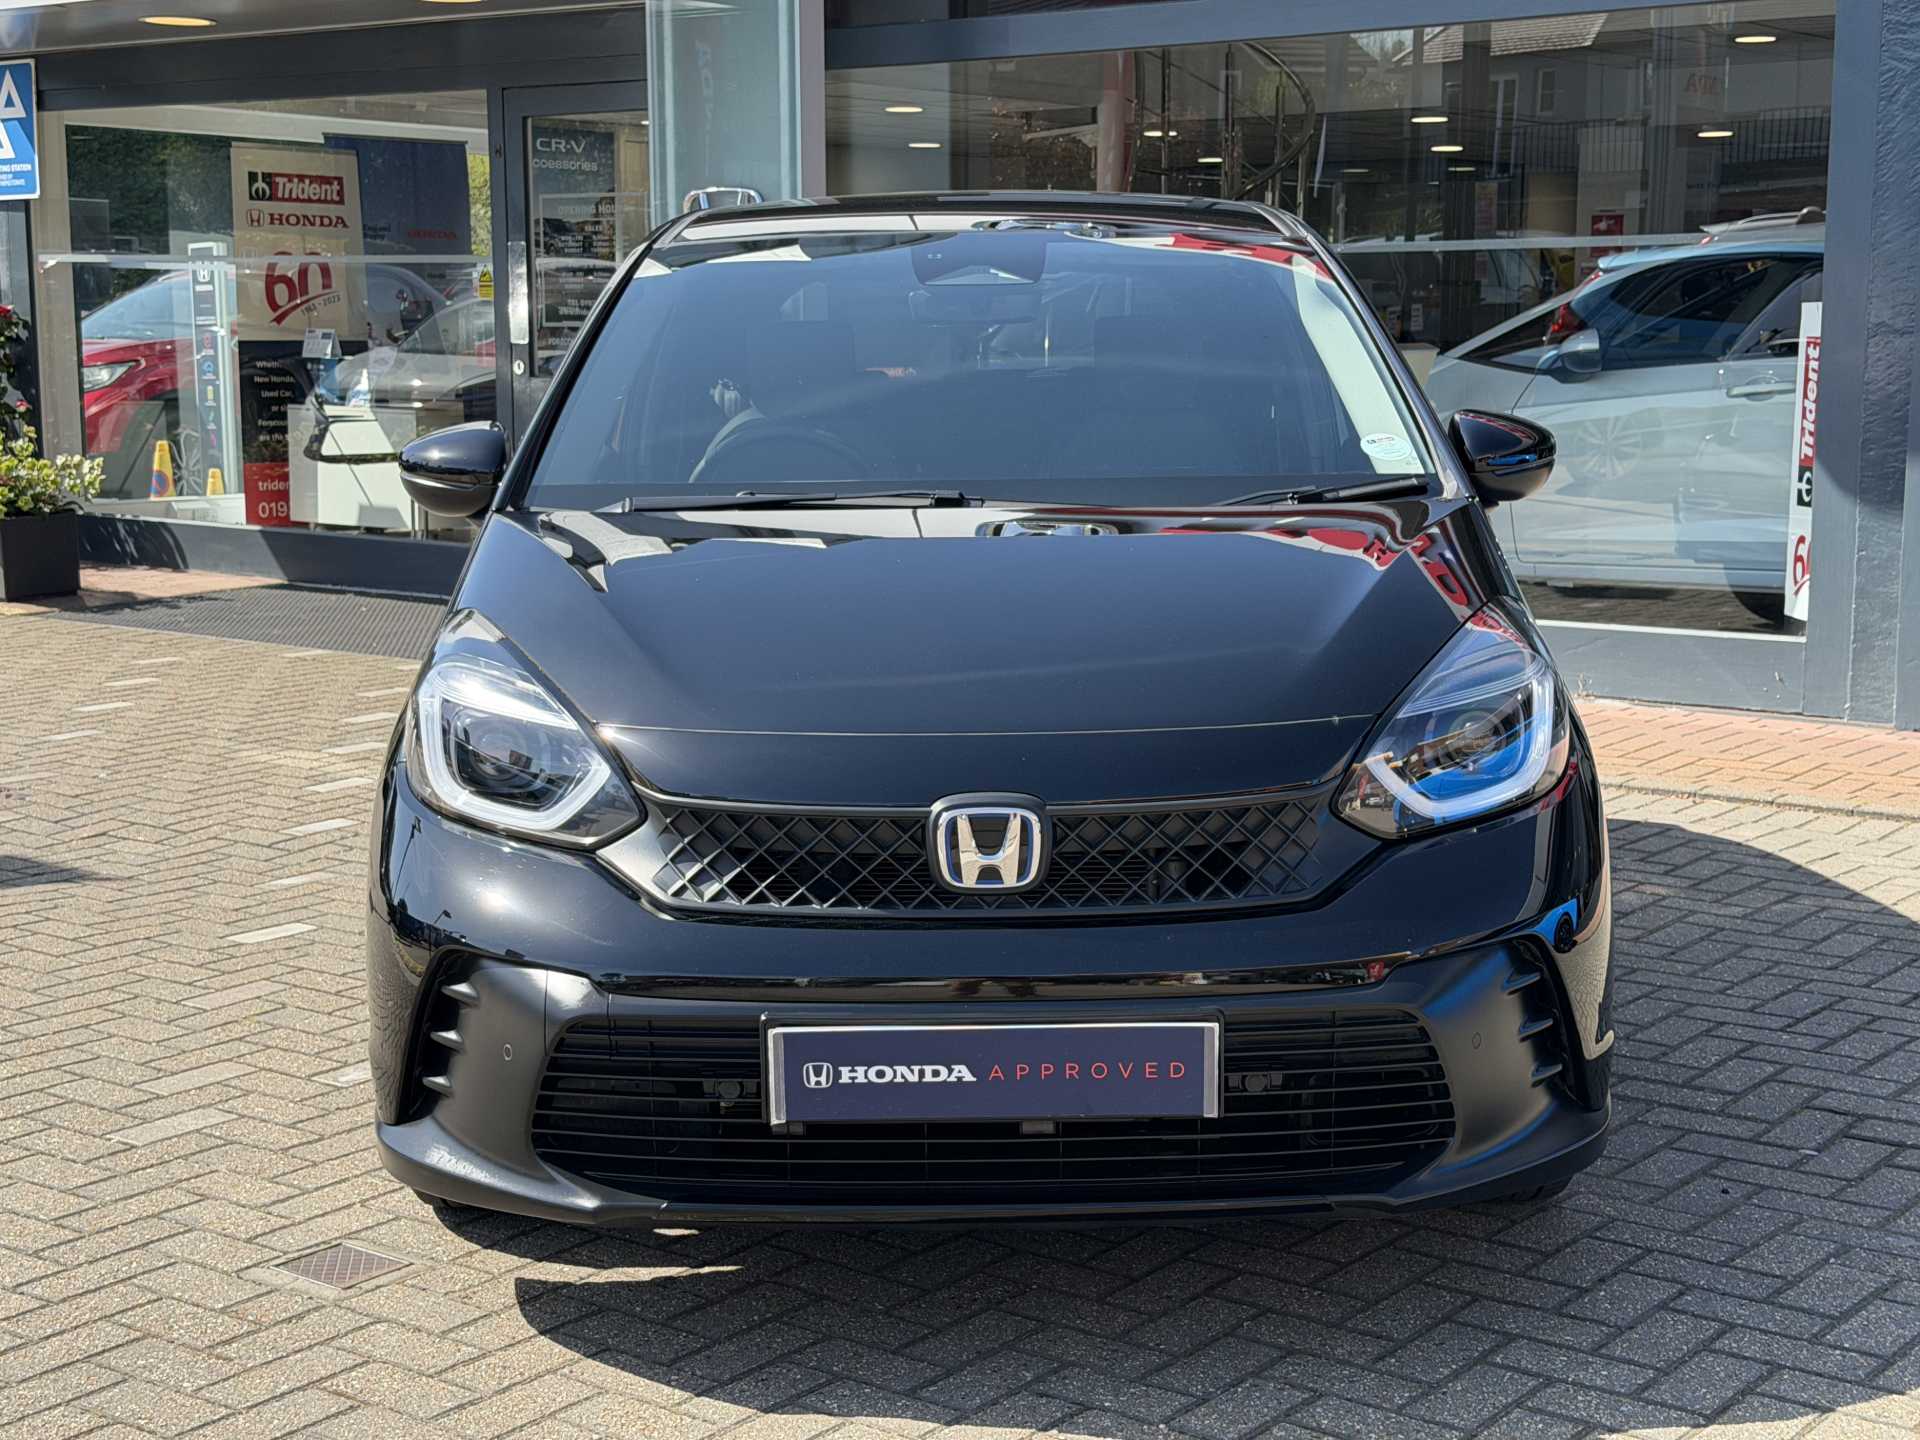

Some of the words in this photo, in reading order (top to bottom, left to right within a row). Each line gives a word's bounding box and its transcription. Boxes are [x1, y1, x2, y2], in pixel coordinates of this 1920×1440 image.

[275, 176, 341, 201] Trident
[268, 212, 350, 229] HONDA
[1801, 342, 1822, 459] Trident
[1793, 535, 1810, 592] 6
[838, 1064, 976, 1083] HONDA
[988, 1061, 1186, 1081] APPROVED
